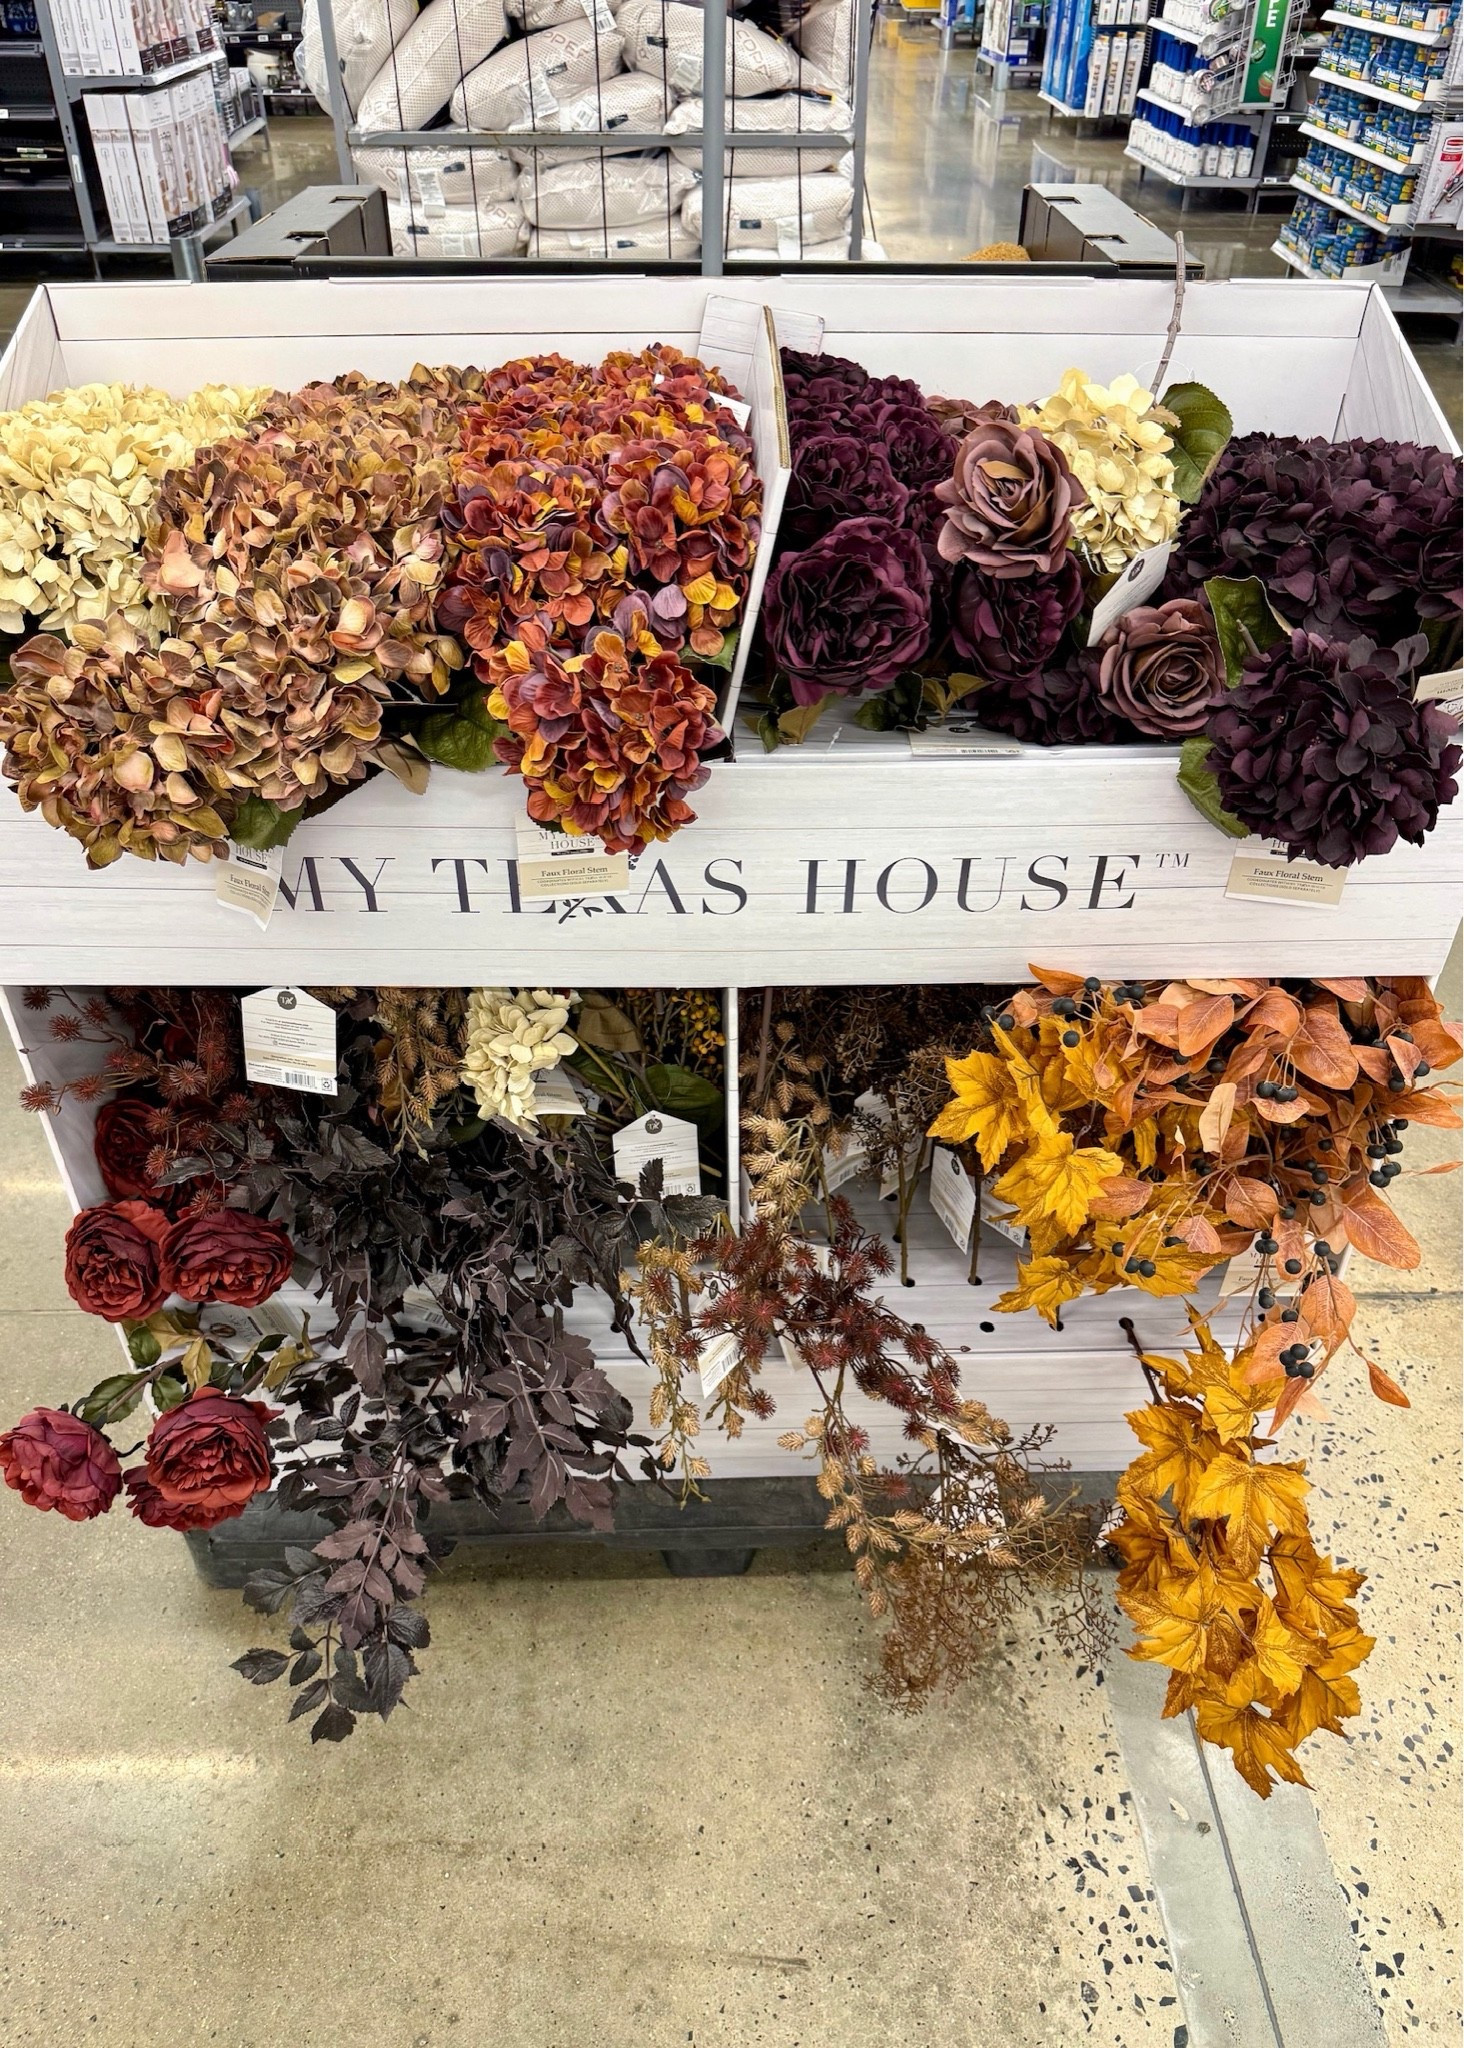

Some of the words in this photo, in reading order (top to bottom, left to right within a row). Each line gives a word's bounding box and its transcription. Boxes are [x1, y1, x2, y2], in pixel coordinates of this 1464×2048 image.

[551, 838, 595, 850] HOUSE
[541, 870, 561, 878] Faux
[562, 867, 586, 876] Floral
[587, 866, 608, 874] Stem
[1253, 868, 1274, 877] Faux
[1275, 870, 1300, 880] Floral
[1301, 873, 1324, 883] Stem
[272, 856, 396, 913] MY
[796, 853, 1141, 914] HOUSE
